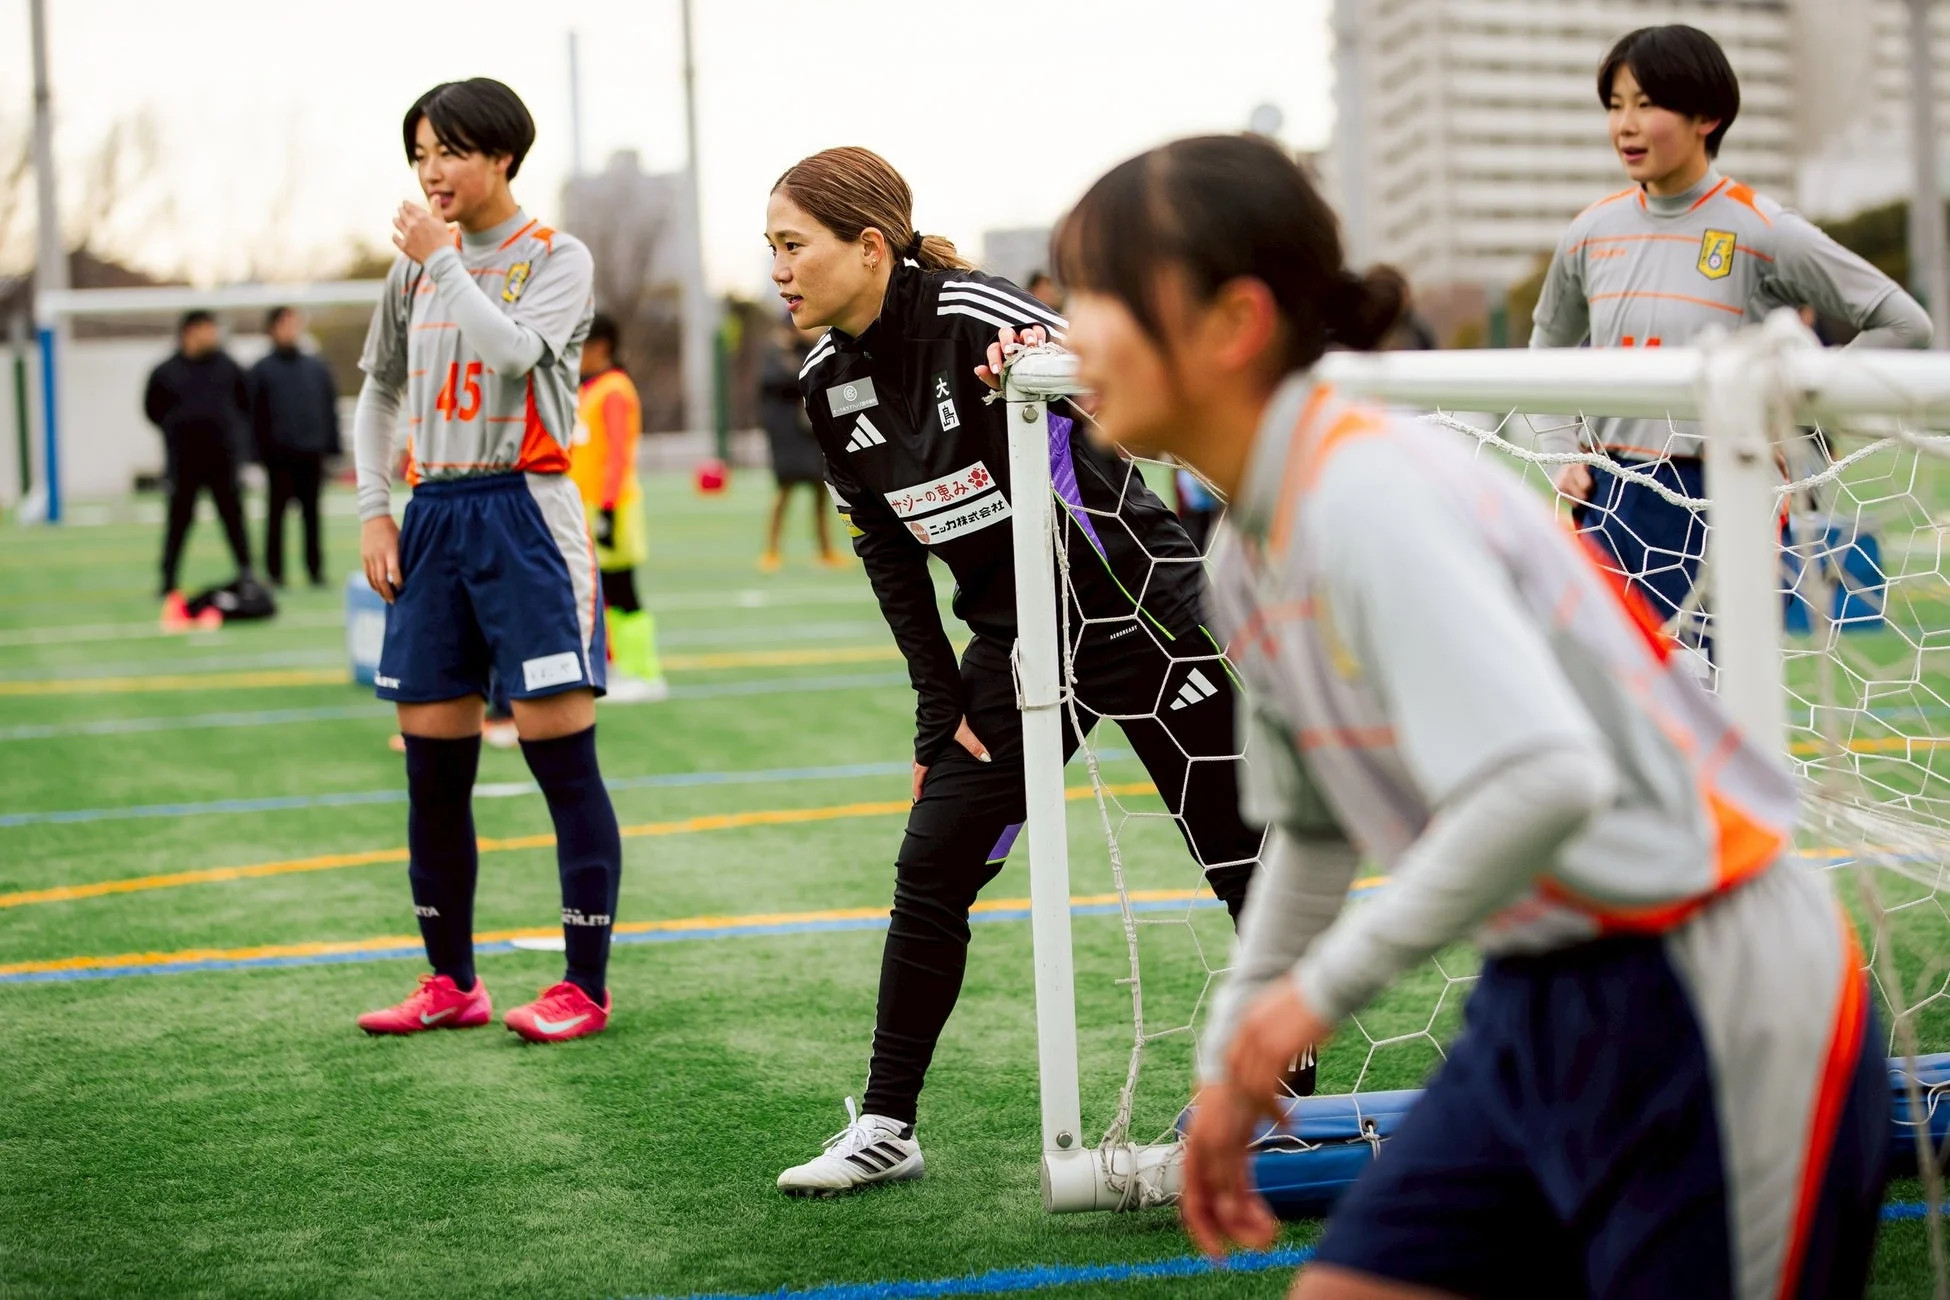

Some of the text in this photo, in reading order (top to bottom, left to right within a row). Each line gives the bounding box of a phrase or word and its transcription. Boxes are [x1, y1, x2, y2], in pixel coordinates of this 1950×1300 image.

[436, 360, 482, 422] 45
[937, 377, 955, 427] 大島
[891, 481, 970, 514] サジーの恵み
[929, 499, 1006, 536] ニッカ株式会社
